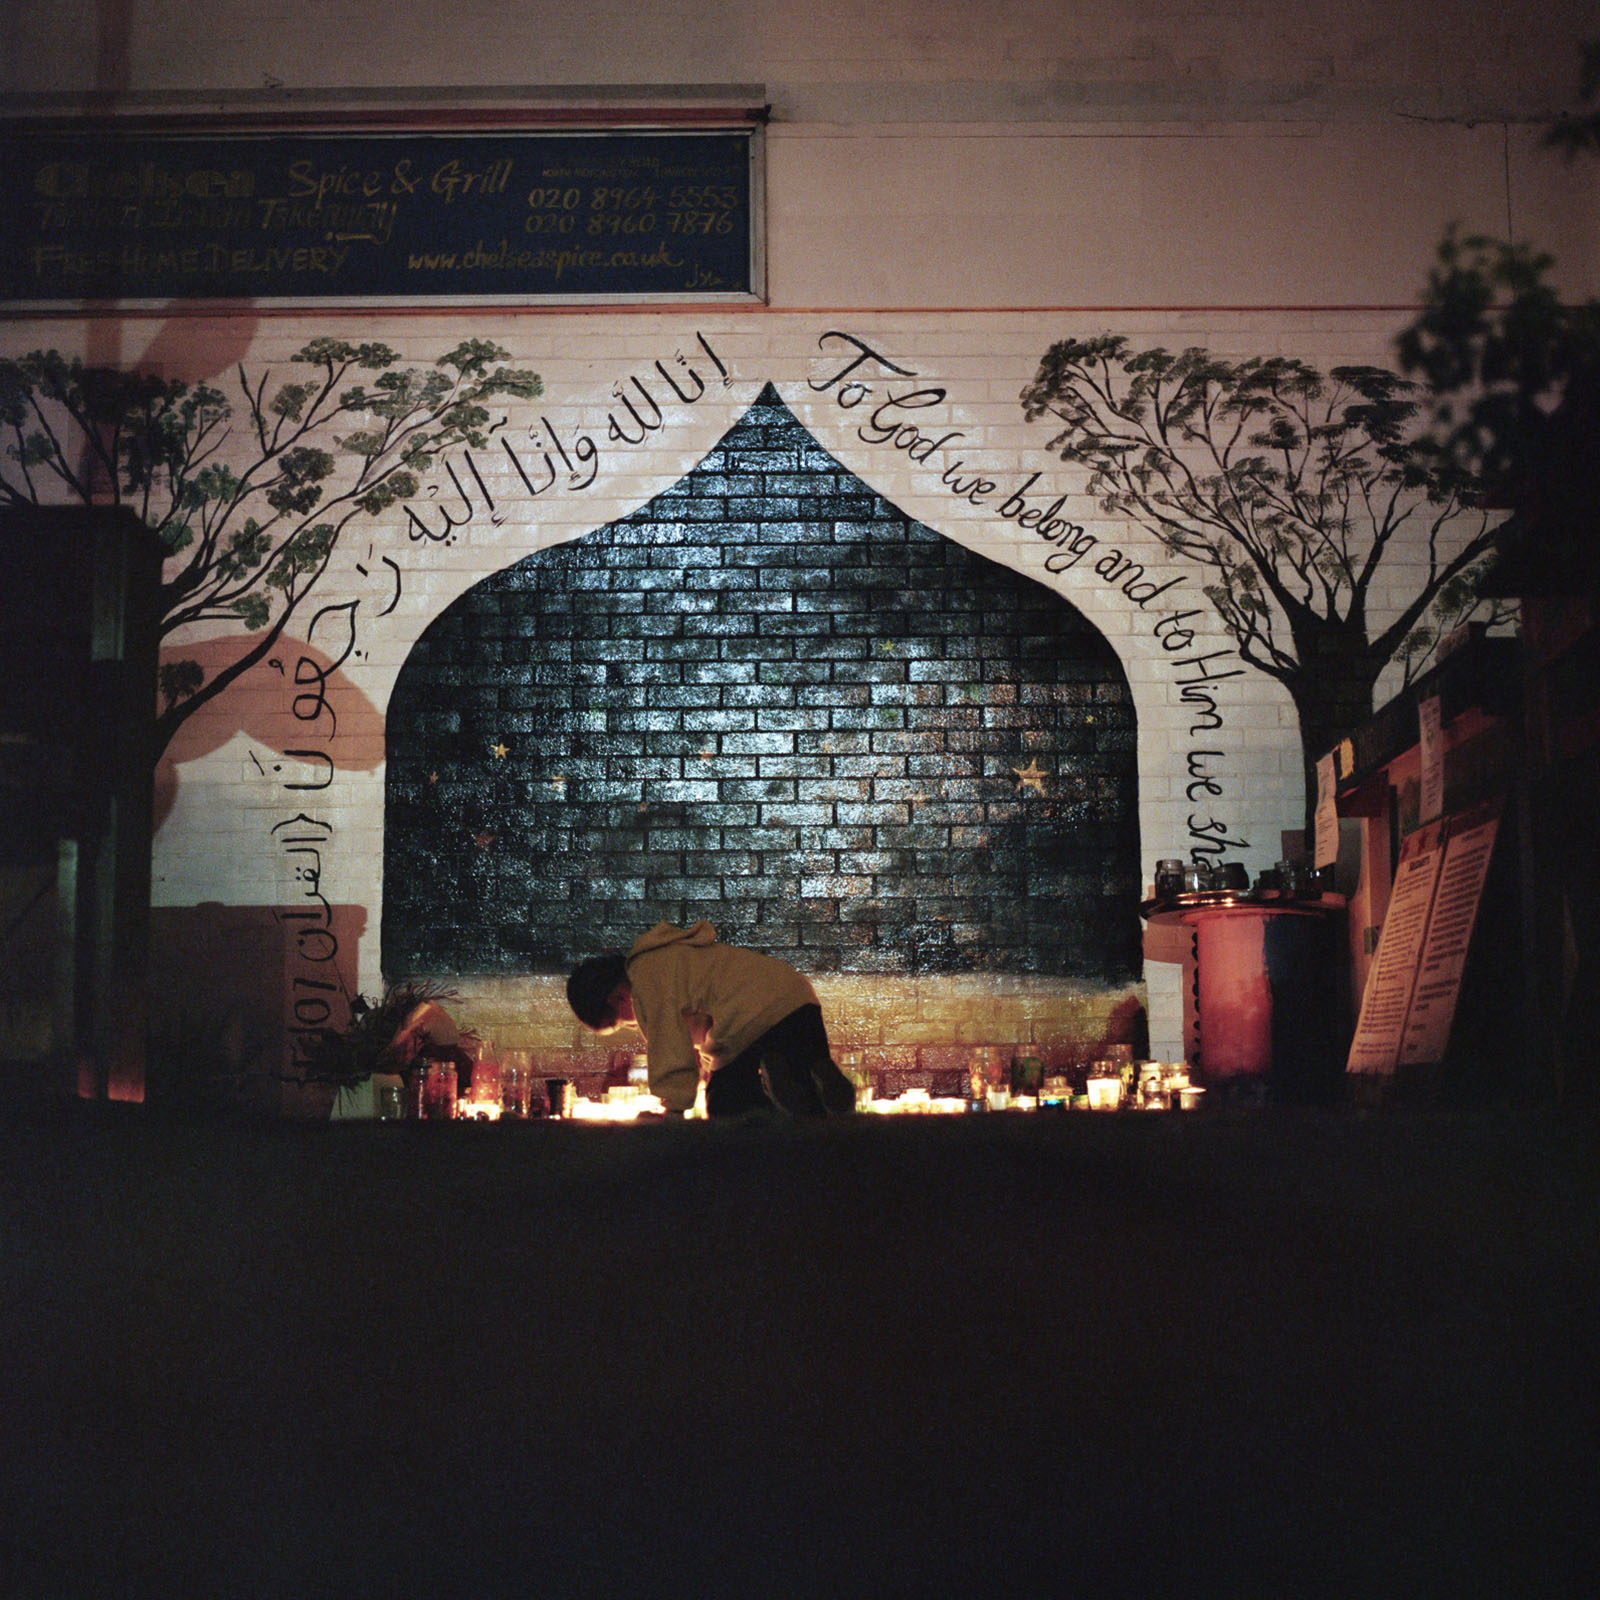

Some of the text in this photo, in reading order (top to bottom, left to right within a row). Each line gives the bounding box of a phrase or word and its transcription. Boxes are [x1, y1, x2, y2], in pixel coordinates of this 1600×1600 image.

[288, 159, 382, 210] Spice
[391, 158, 423, 194] &
[431, 158, 514, 204] Grill
[528, 188, 580, 210] 020
[590, 185, 662, 210] 8964
[525, 210, 735, 236] 020 8960 7876
[807, 330, 917, 408] To
[857, 388, 964, 464] God
[941, 462, 996, 504] we
[997, 472, 1100, 574] belong
[1096, 550, 1187, 609] and
[1153, 610, 1202, 651] to
[1171, 650, 1244, 736] Him
[1187, 749, 1225, 801] we
